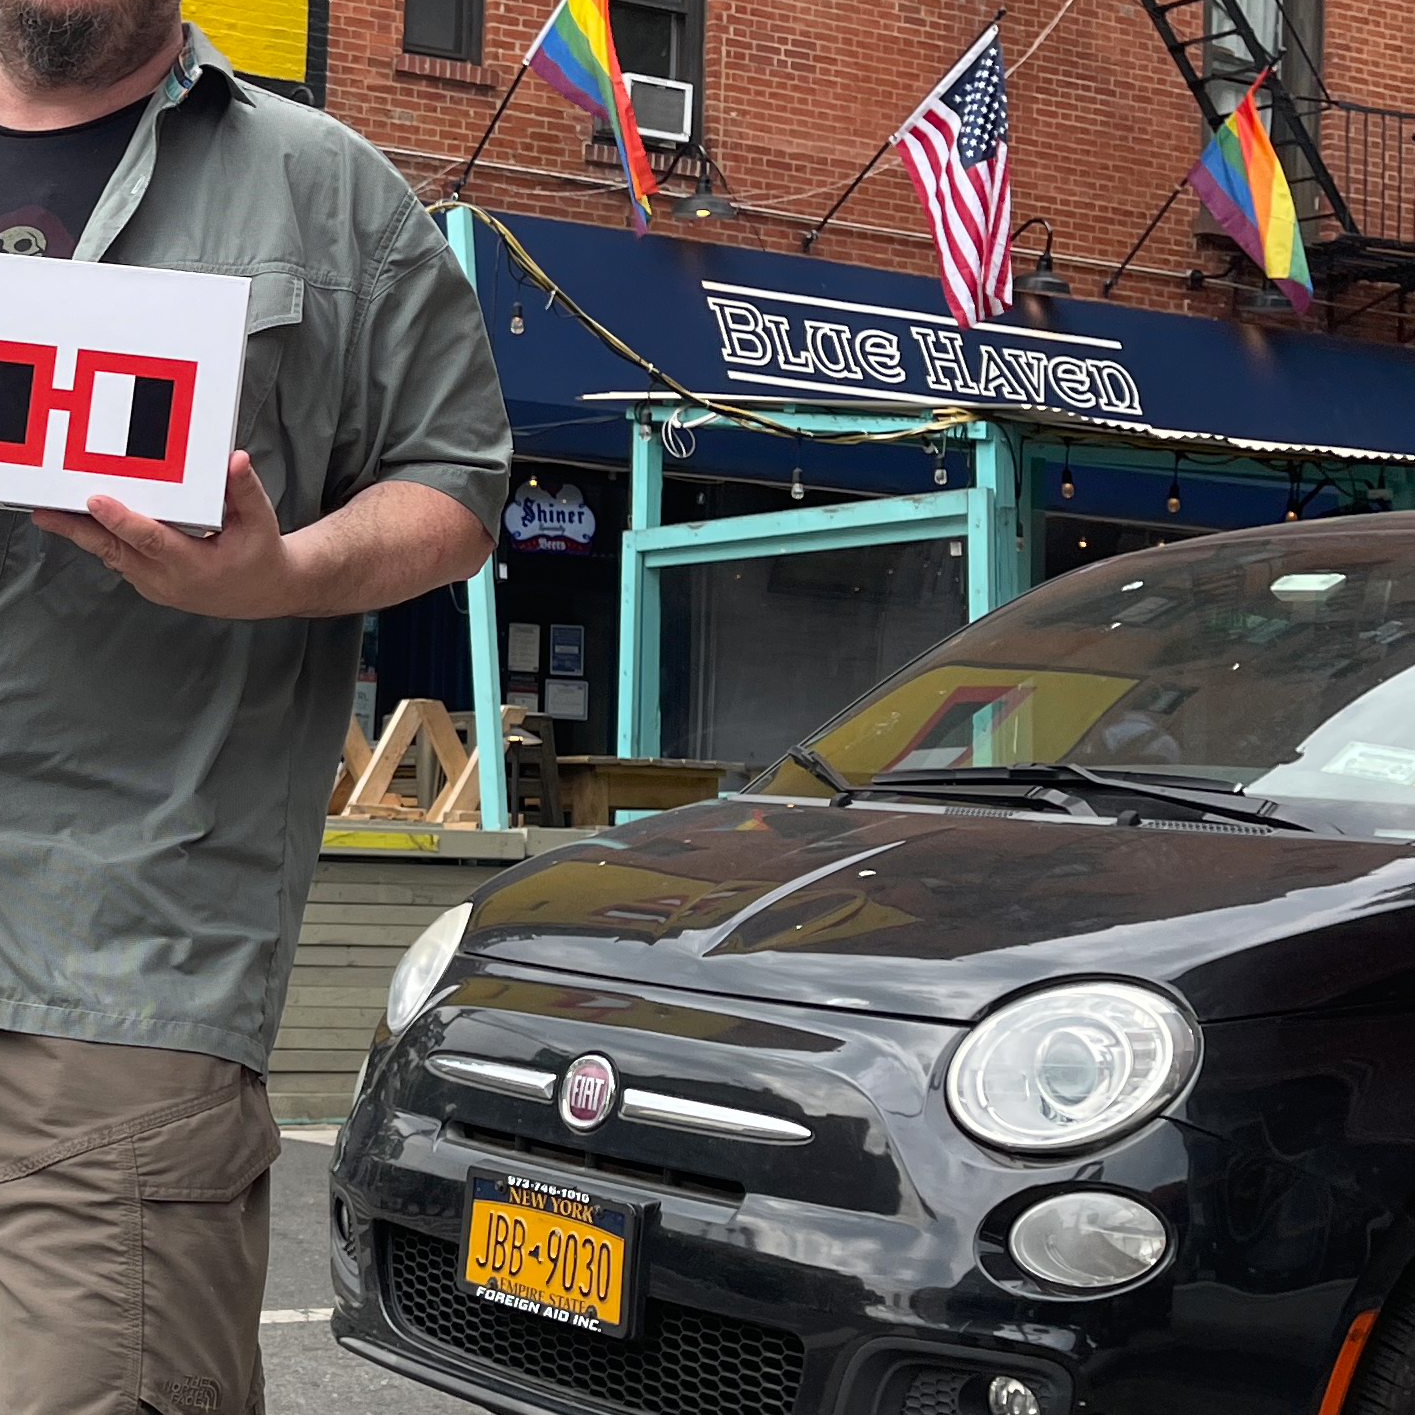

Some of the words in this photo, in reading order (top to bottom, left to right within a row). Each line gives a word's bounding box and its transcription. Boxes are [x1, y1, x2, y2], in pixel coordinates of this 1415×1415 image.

[521, 496, 585, 527] Shiner
[571, 1074, 605, 1111] FIAT
[509, 1186, 547, 1210] NEW
[551, 1196, 594, 1224] YORK
[476, 1286, 540, 1314] FOREIGN
[543, 1306, 570, 1323] AID
[572, 1314, 603, 1333] INC.
[499, 1276, 545, 1303] EMPIRE
[549, 1293, 587, 1314] STATE
[184, 1374, 211, 1387] THE
[171, 1392, 205, 1408] FACE
